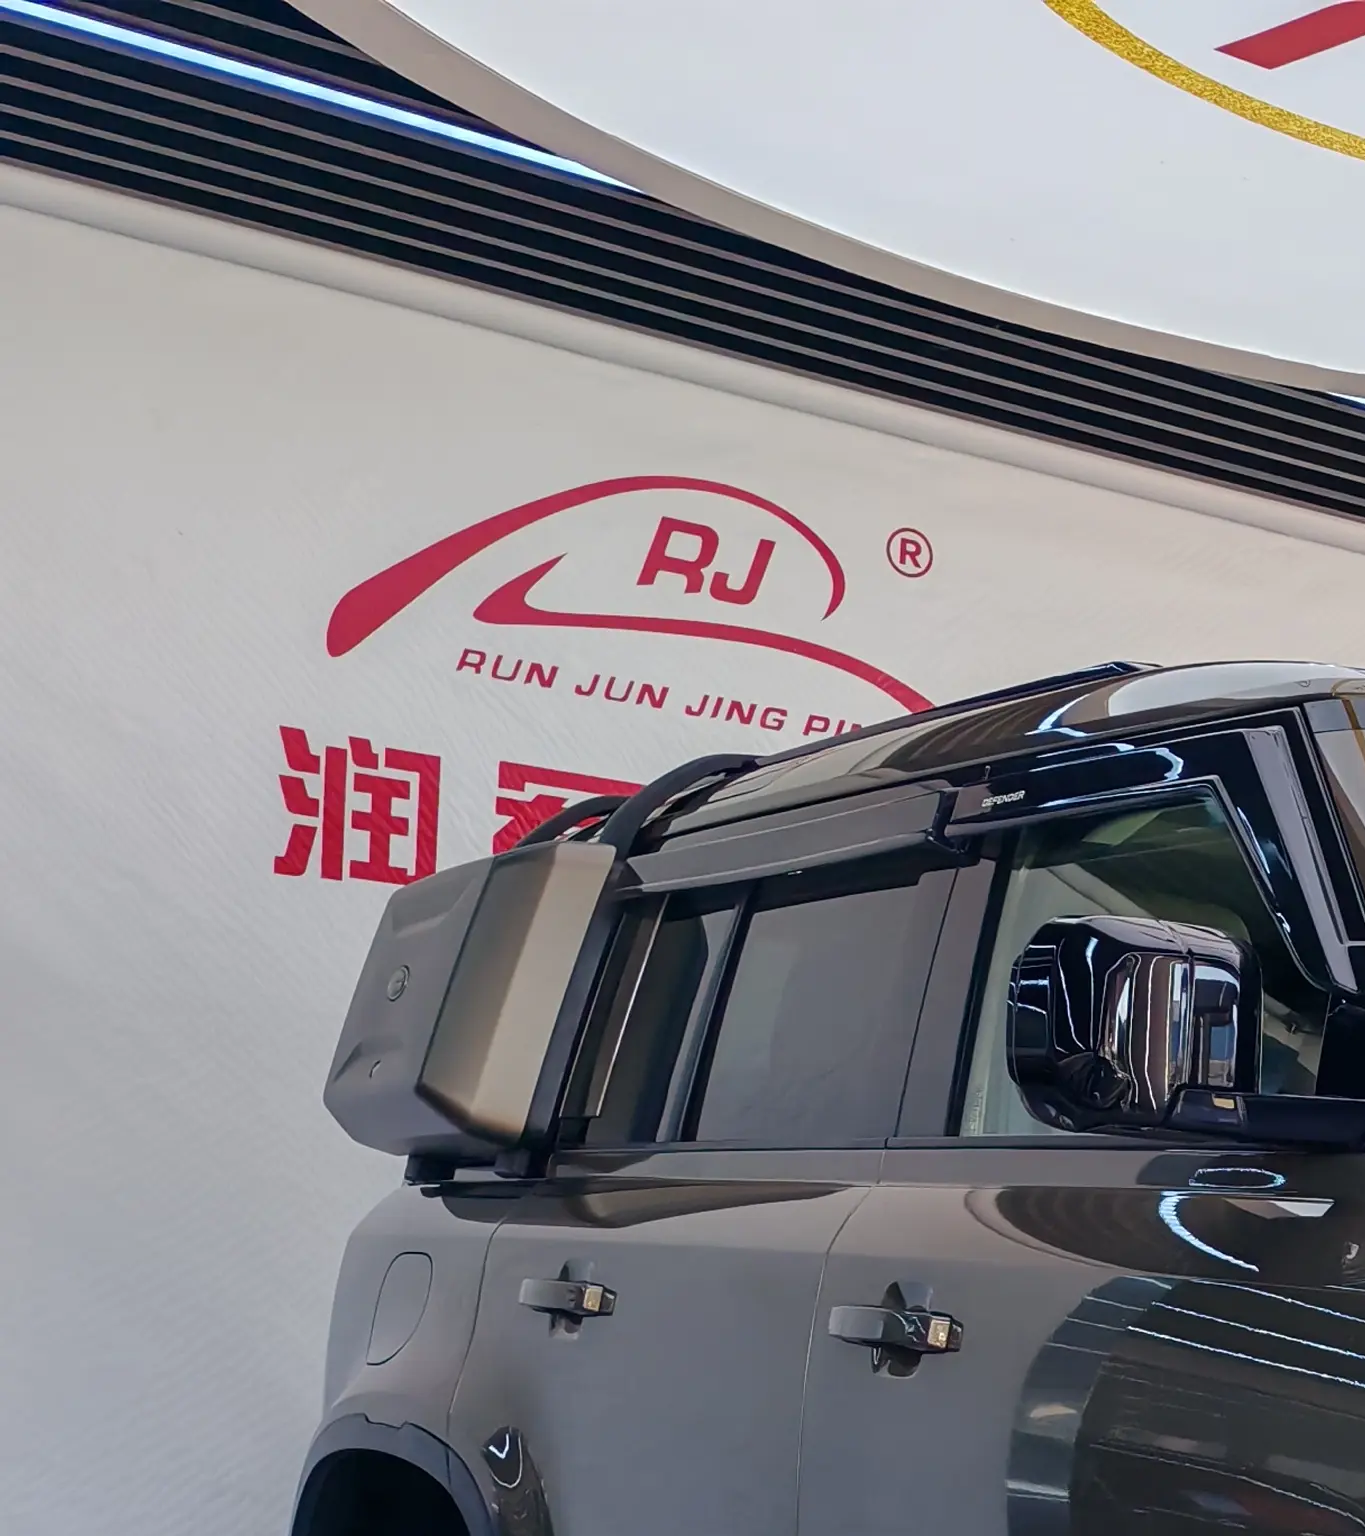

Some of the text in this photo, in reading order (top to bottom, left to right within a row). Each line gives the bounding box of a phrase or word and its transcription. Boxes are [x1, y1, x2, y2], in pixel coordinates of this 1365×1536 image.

[636, 515, 777, 606] RJ
[456, 648, 559, 689] RUN
[574, 674, 669, 710] JUN
[684, 692, 789, 733] JING
